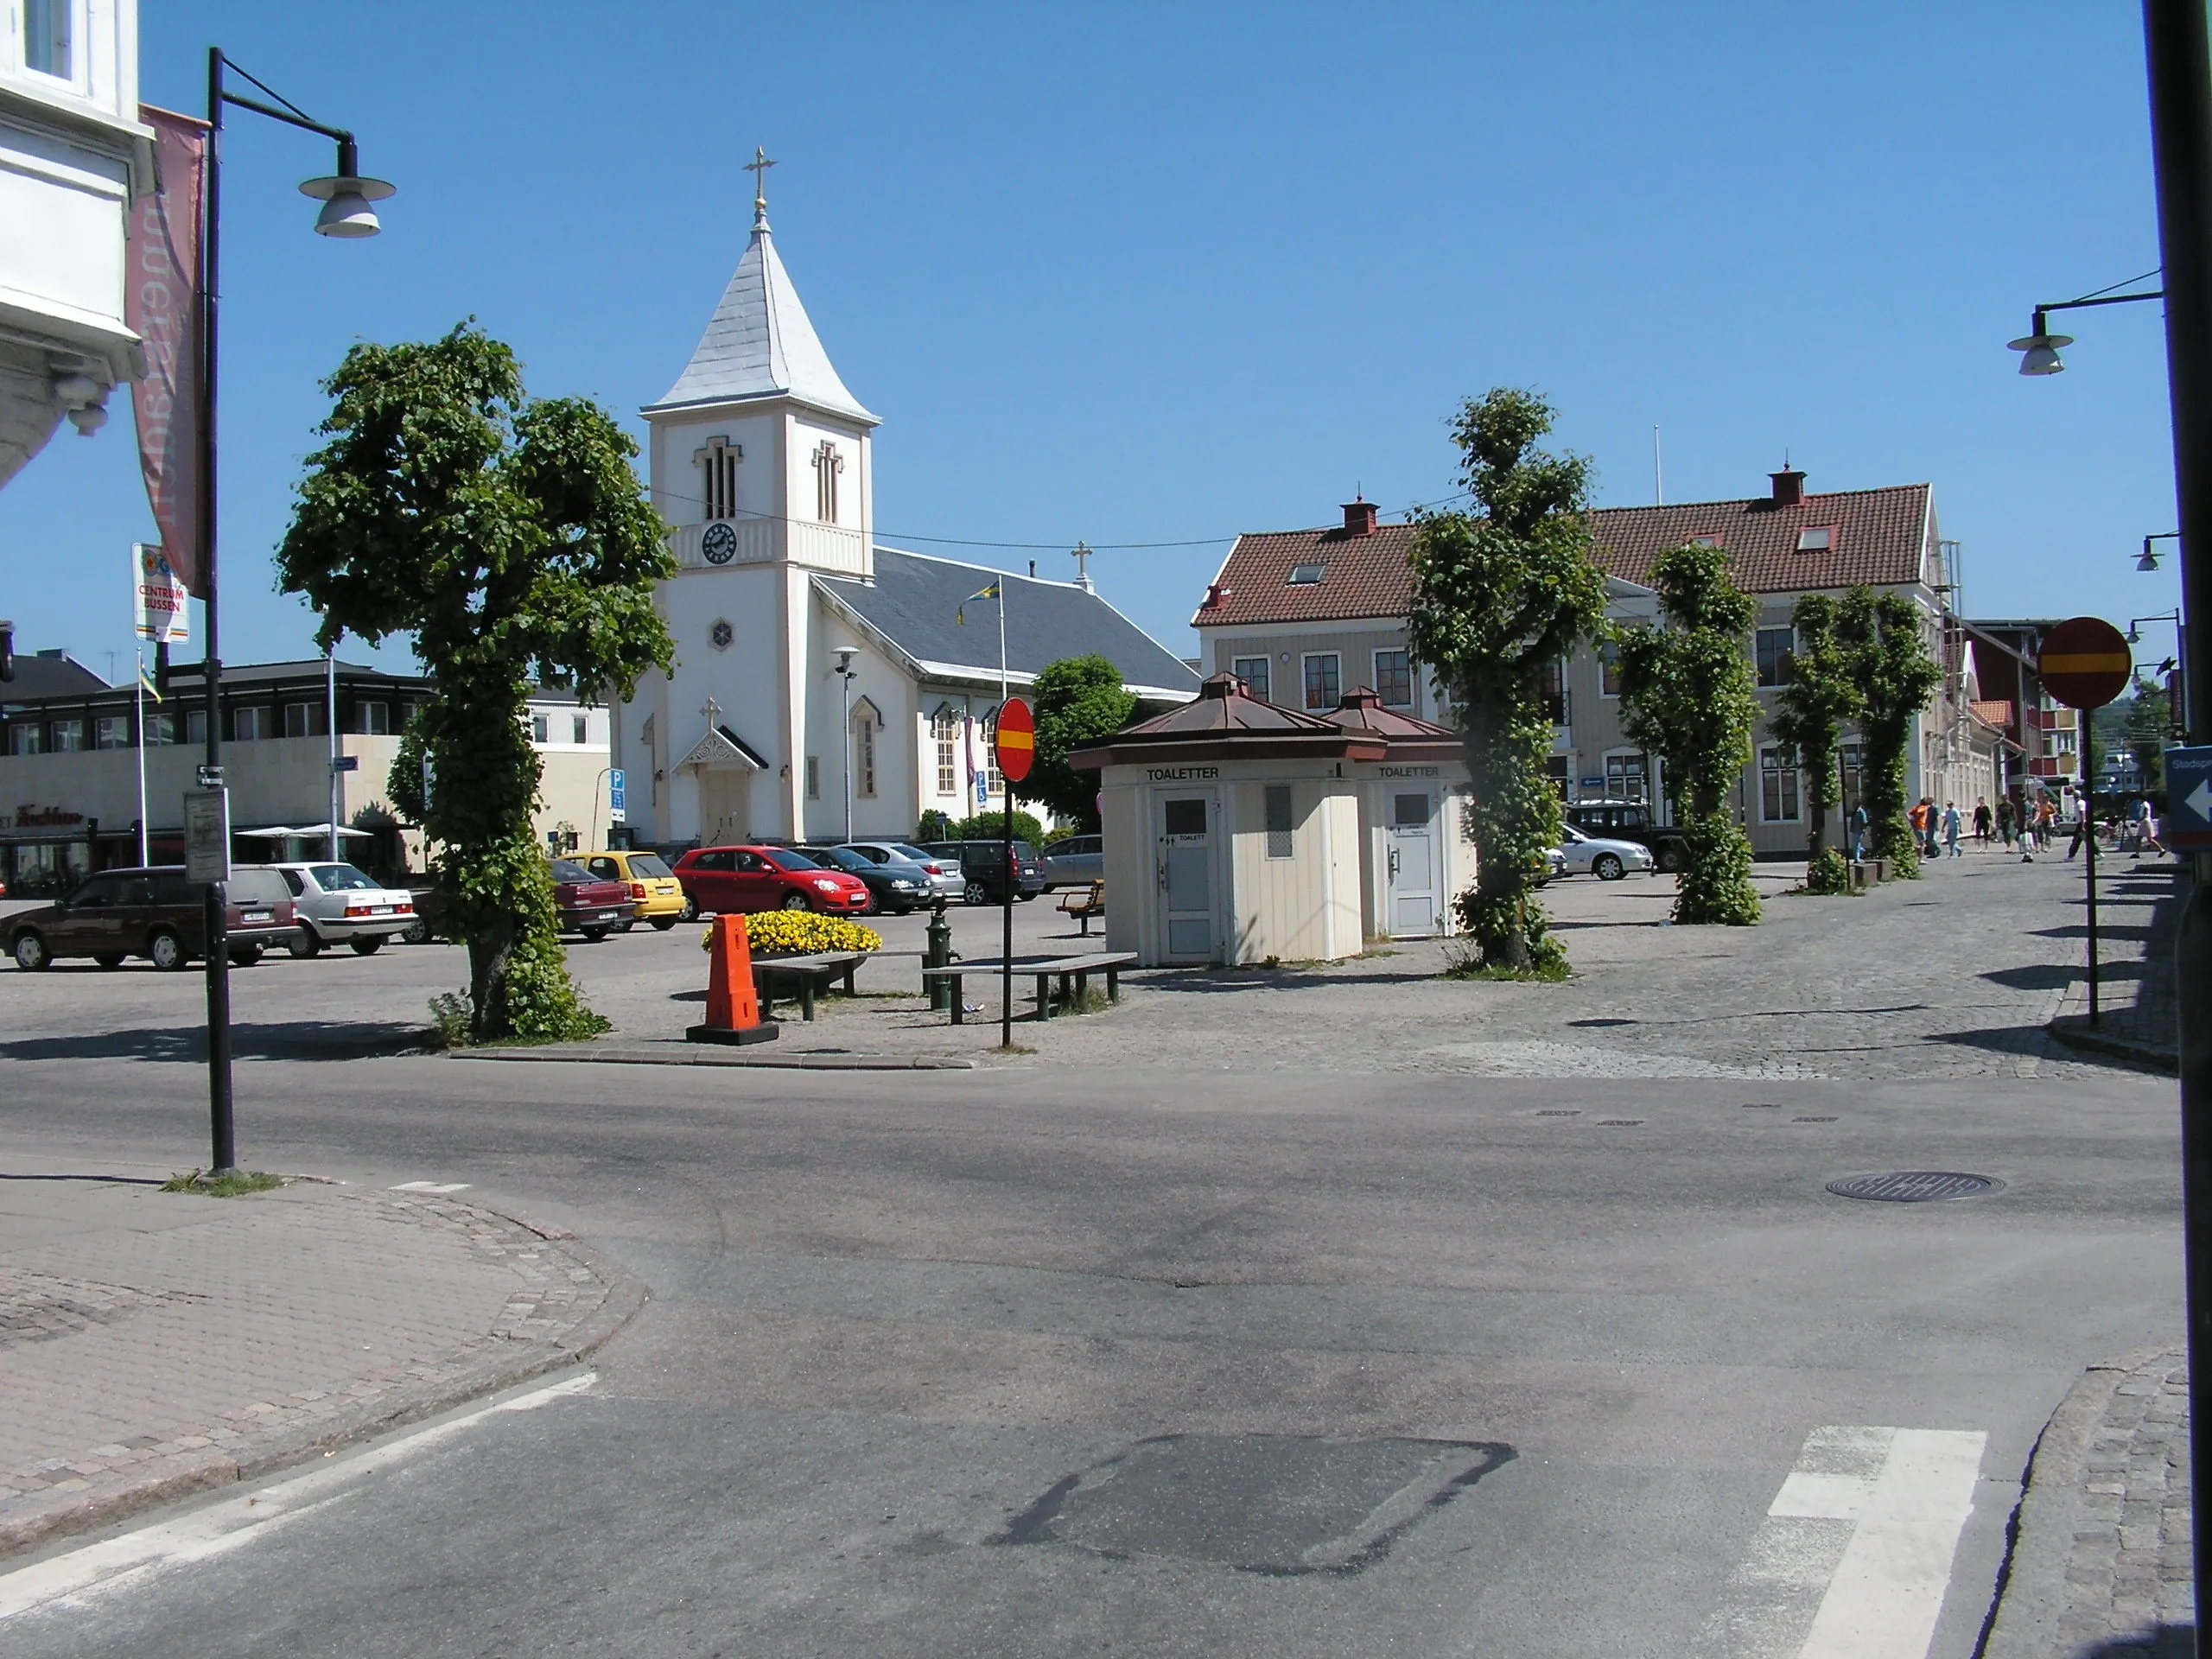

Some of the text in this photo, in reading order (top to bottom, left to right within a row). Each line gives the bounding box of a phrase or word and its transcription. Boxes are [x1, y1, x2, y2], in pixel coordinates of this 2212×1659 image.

[139, 584, 184, 601] CENTRUM
[144, 597, 180, 612] BUSSEN
[1147, 767, 1218, 780] TOALETTER
[1379, 766, 1439, 777] TOALETTER
